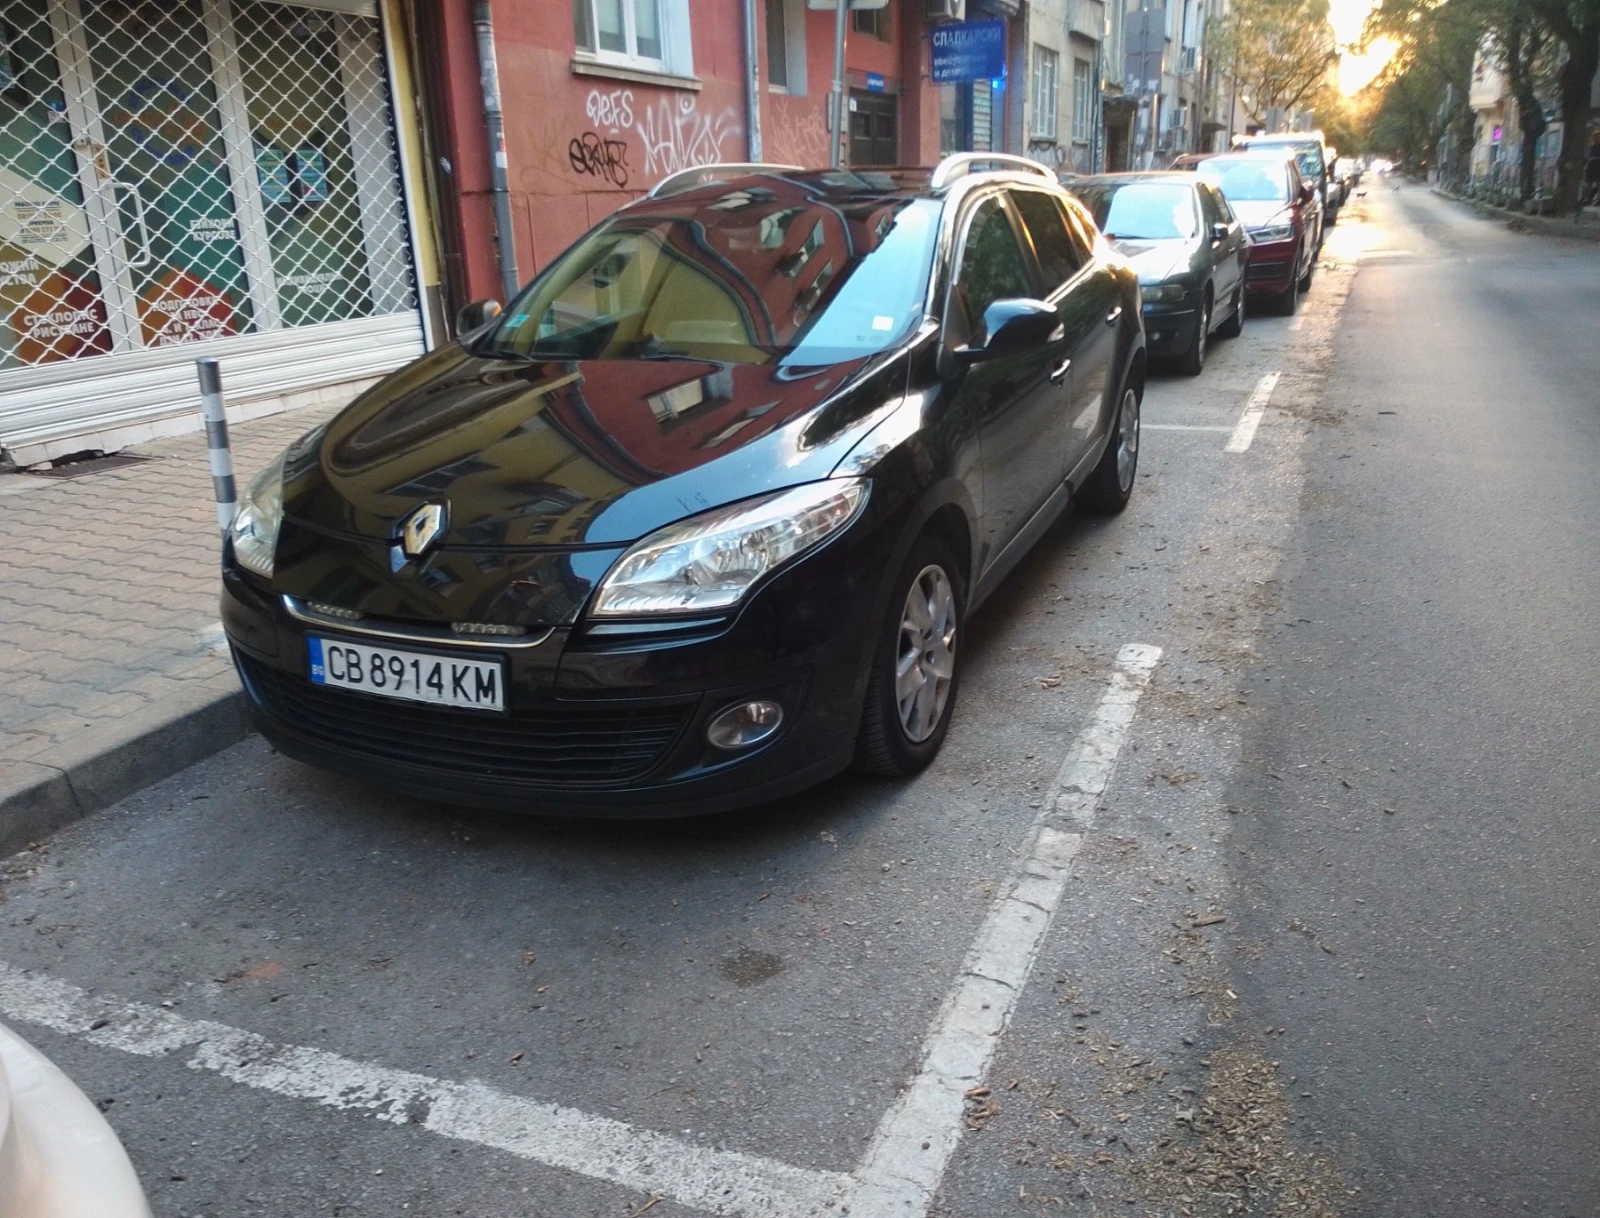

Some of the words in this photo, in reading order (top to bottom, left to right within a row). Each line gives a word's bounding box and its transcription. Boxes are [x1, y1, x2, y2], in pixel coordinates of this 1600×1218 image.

[152, 297, 219, 311] ОДГООВК
[23, 309, 99, 326] СТКЛОПС
[33, 322, 95, 338] РИСУАНЕ
[328, 645, 364, 684] CB
[370, 652, 444, 698] 8914
[452, 664, 497, 704] KM
